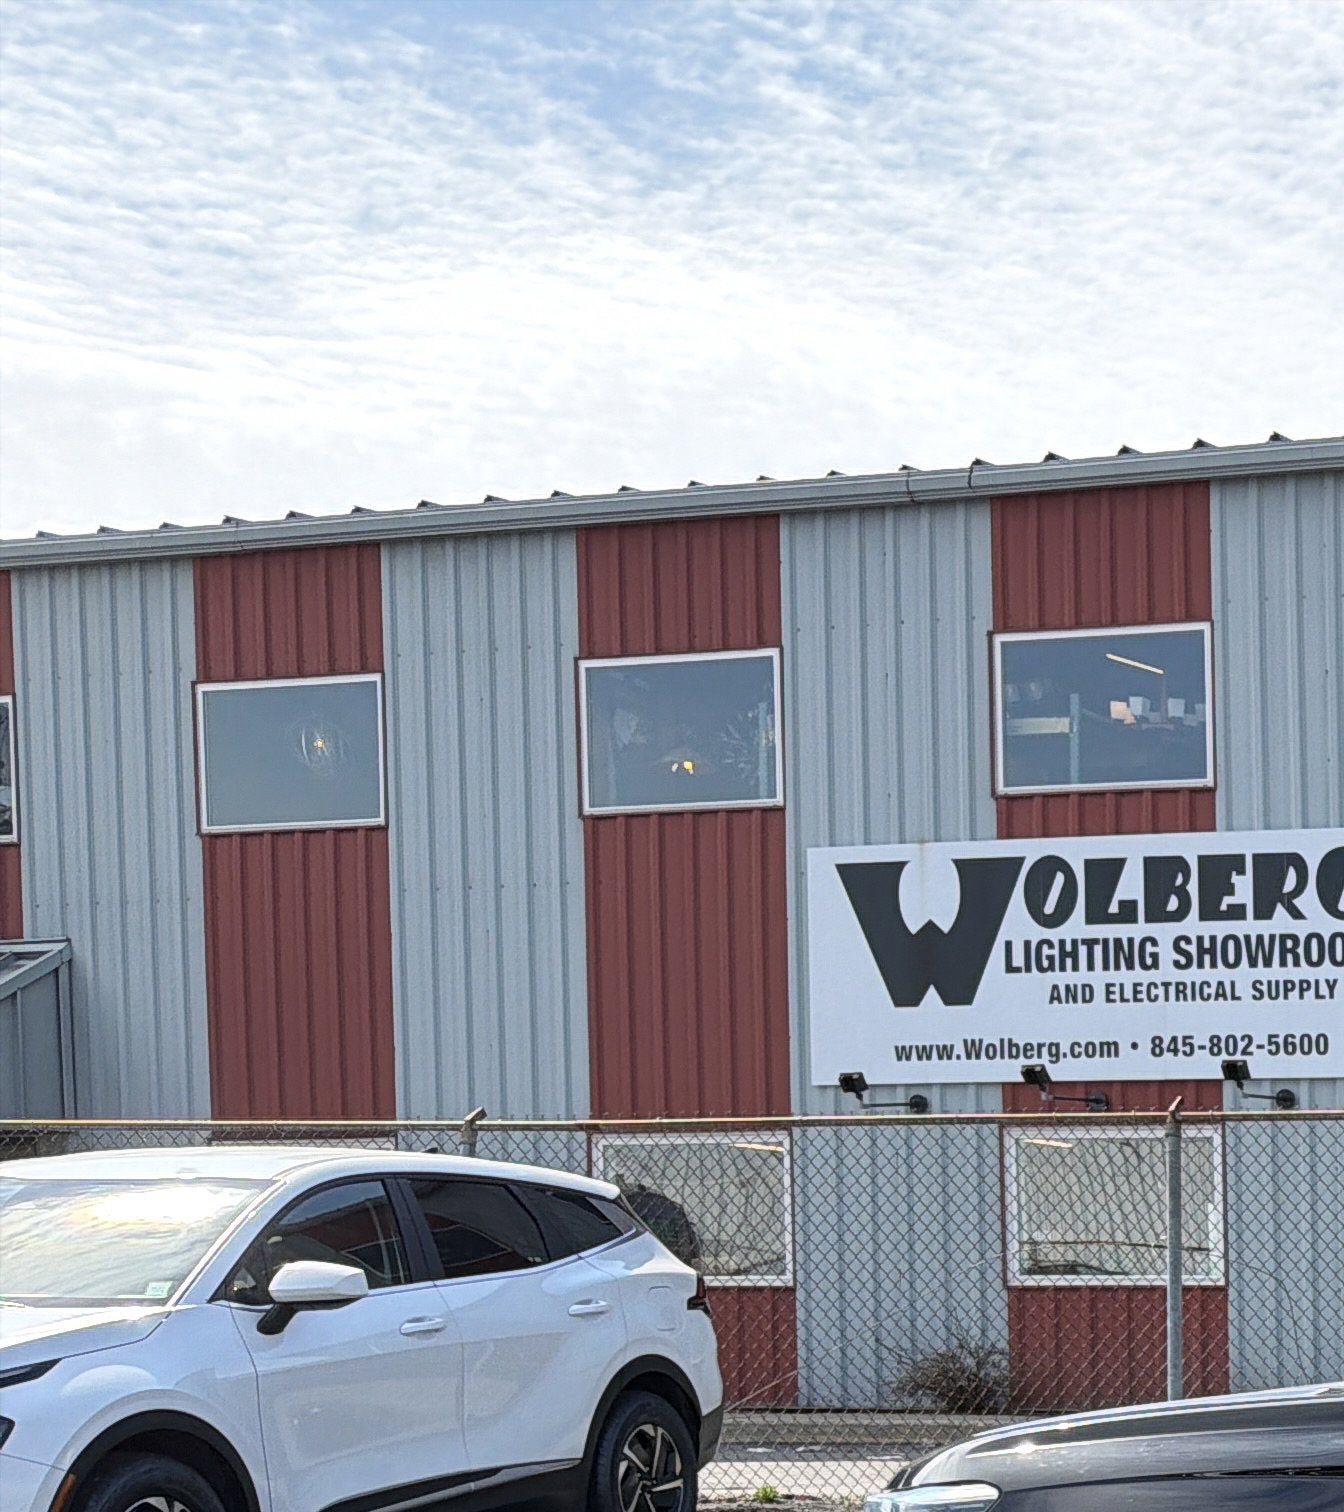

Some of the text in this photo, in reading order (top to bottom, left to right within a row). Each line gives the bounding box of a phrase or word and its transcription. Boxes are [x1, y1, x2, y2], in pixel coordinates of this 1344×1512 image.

[1004, 937, 1160, 974] LIGHTING
[1049, 978, 1339, 1005] AND ELECTRICAL SUPPLY
[894, 1033, 1330, 1064] www.Wolberg.com 845-802-5600
